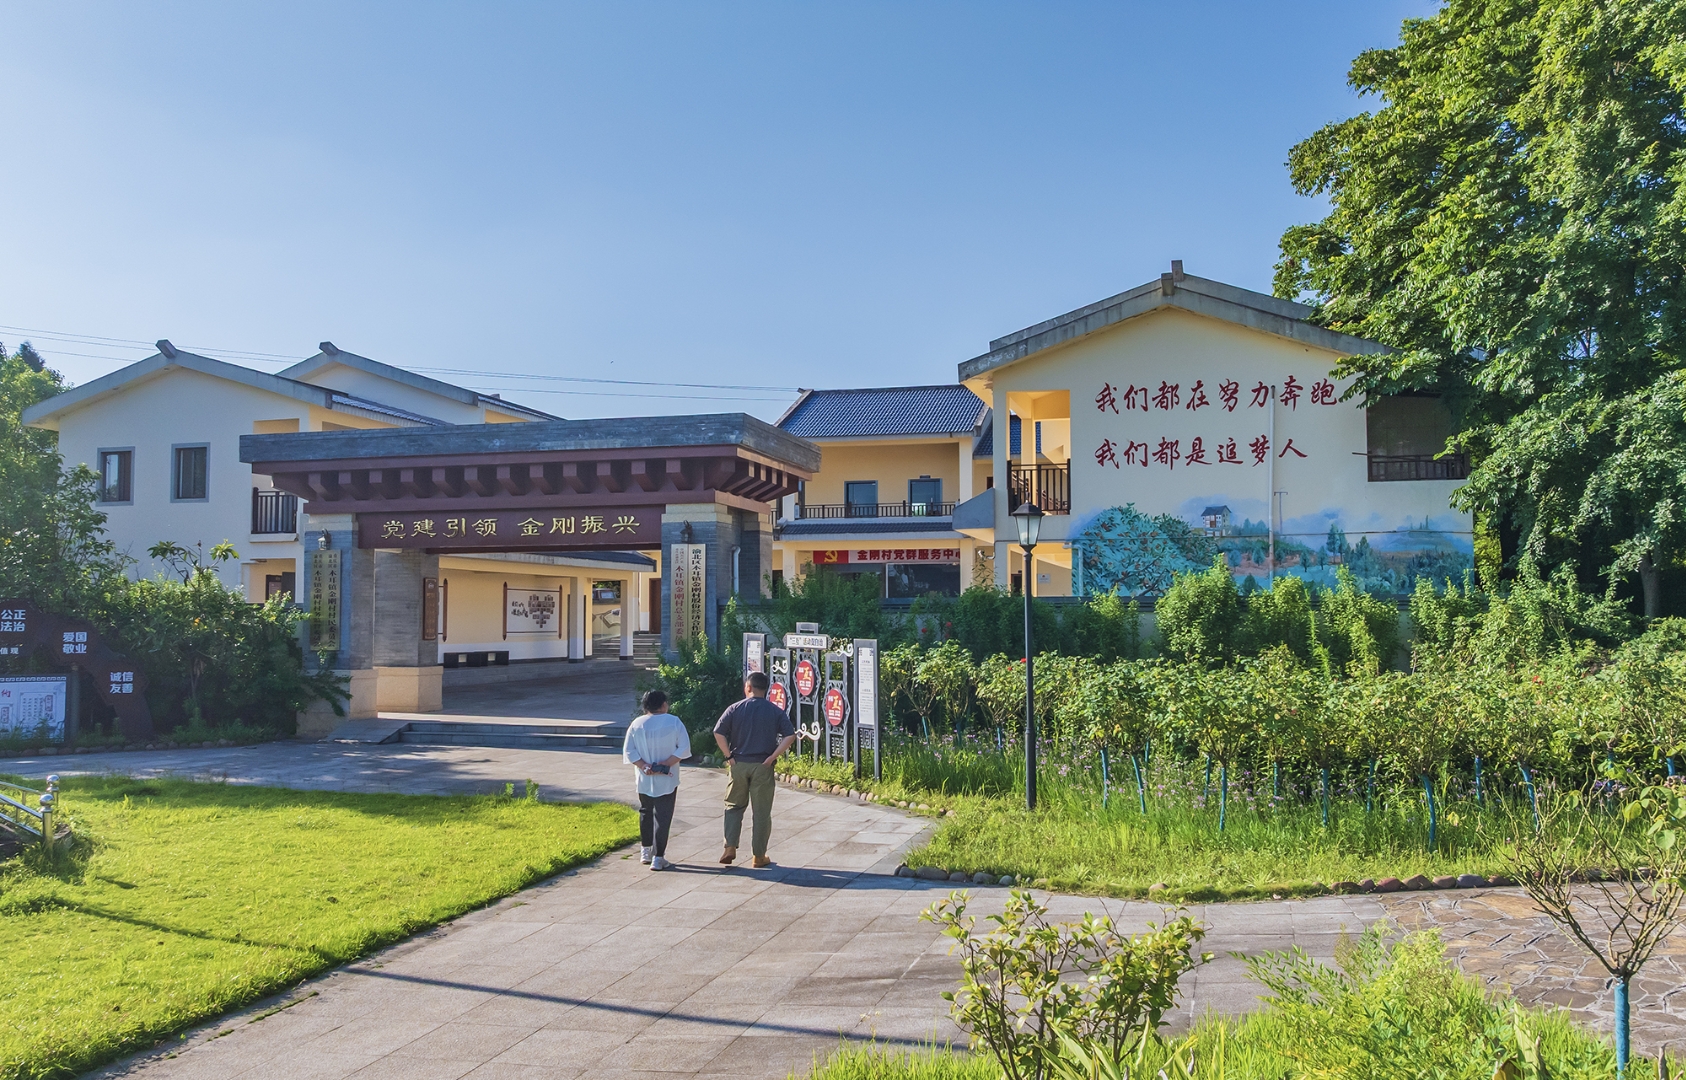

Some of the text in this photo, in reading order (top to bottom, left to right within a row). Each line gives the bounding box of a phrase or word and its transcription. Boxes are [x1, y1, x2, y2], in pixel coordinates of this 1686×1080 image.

[1095, 375, 1339, 414] 我们都在努力奔跑
[1095, 435, 1308, 470] 我们都是追梦人
[380, 515, 640, 539] 党建引领 金刚振兴
[1, 610, 26, 620] 公正
[0, 621, 25, 632] 法治
[63, 632, 87, 643] 爱国
[62, 643, 87, 654] 敬业
[110, 672, 134, 682] 诚信
[110, 683, 134, 694] 友善
